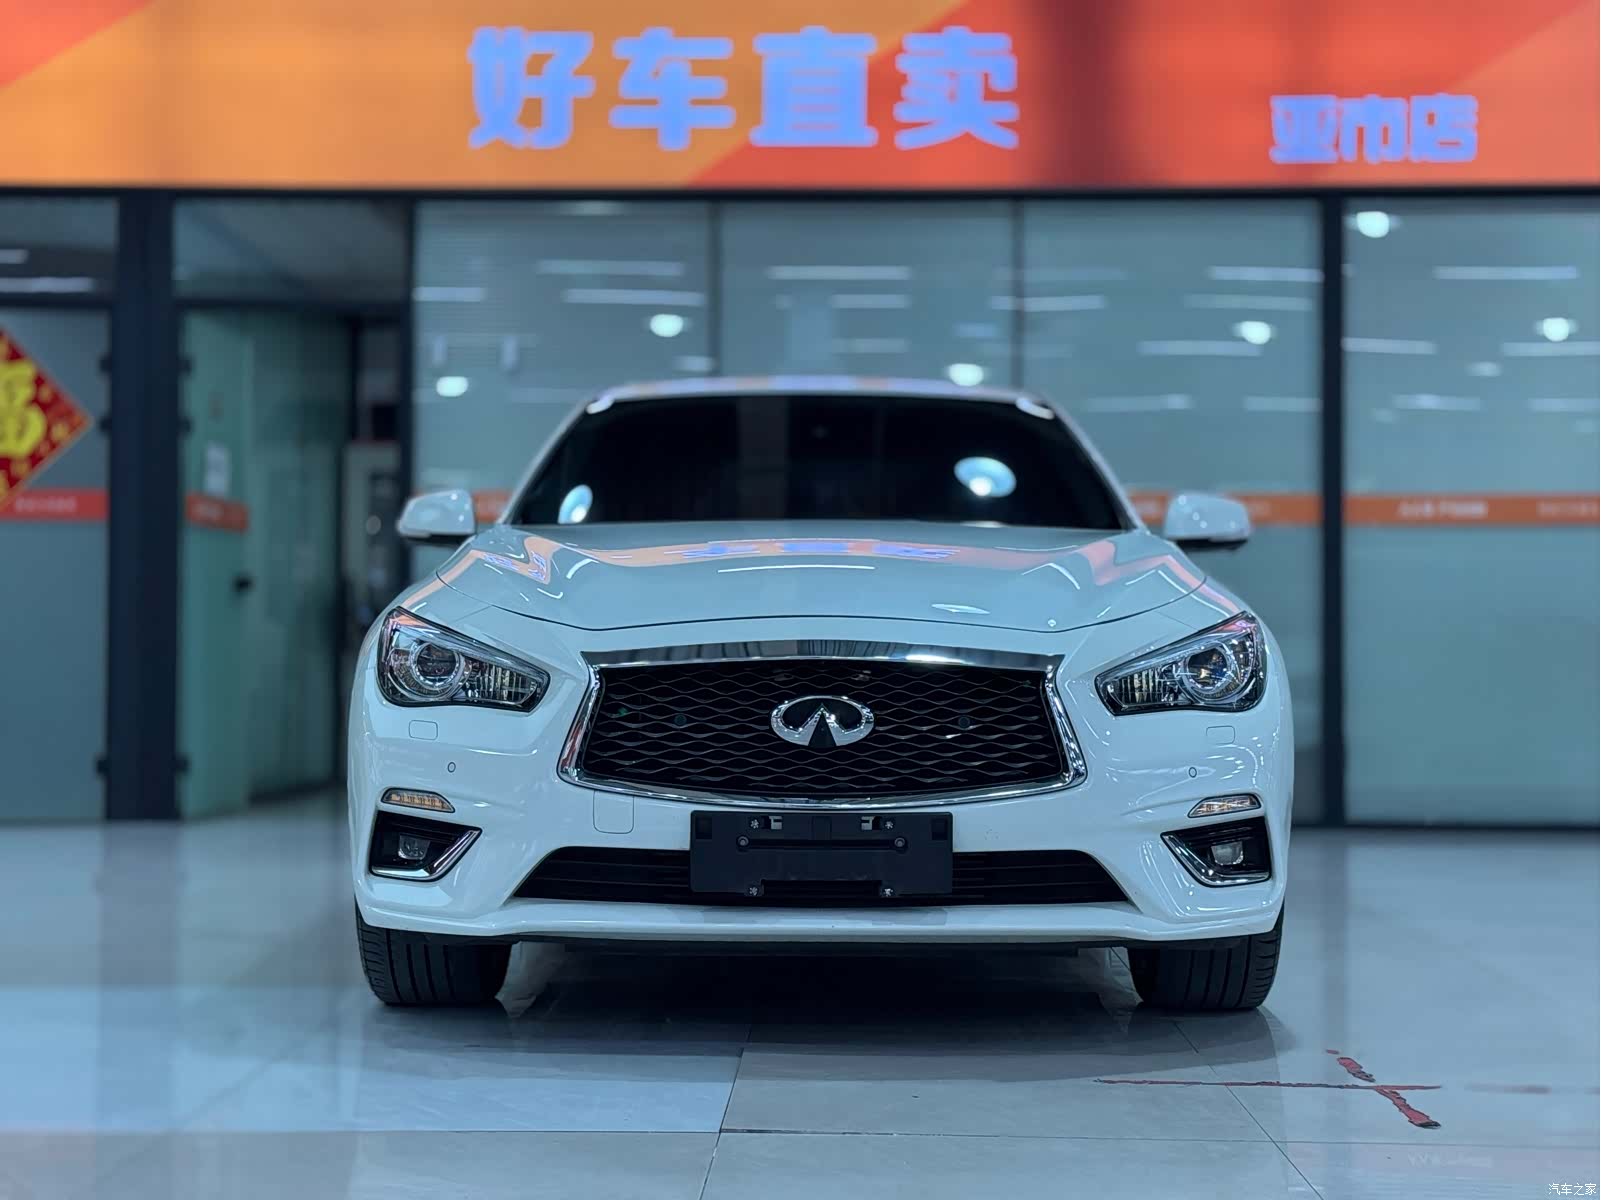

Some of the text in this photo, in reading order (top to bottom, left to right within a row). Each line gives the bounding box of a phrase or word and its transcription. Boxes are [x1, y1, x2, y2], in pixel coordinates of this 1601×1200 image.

[467, 26, 1020, 151] 好车直卖
[1269, 93, 1478, 165] 亚市店
